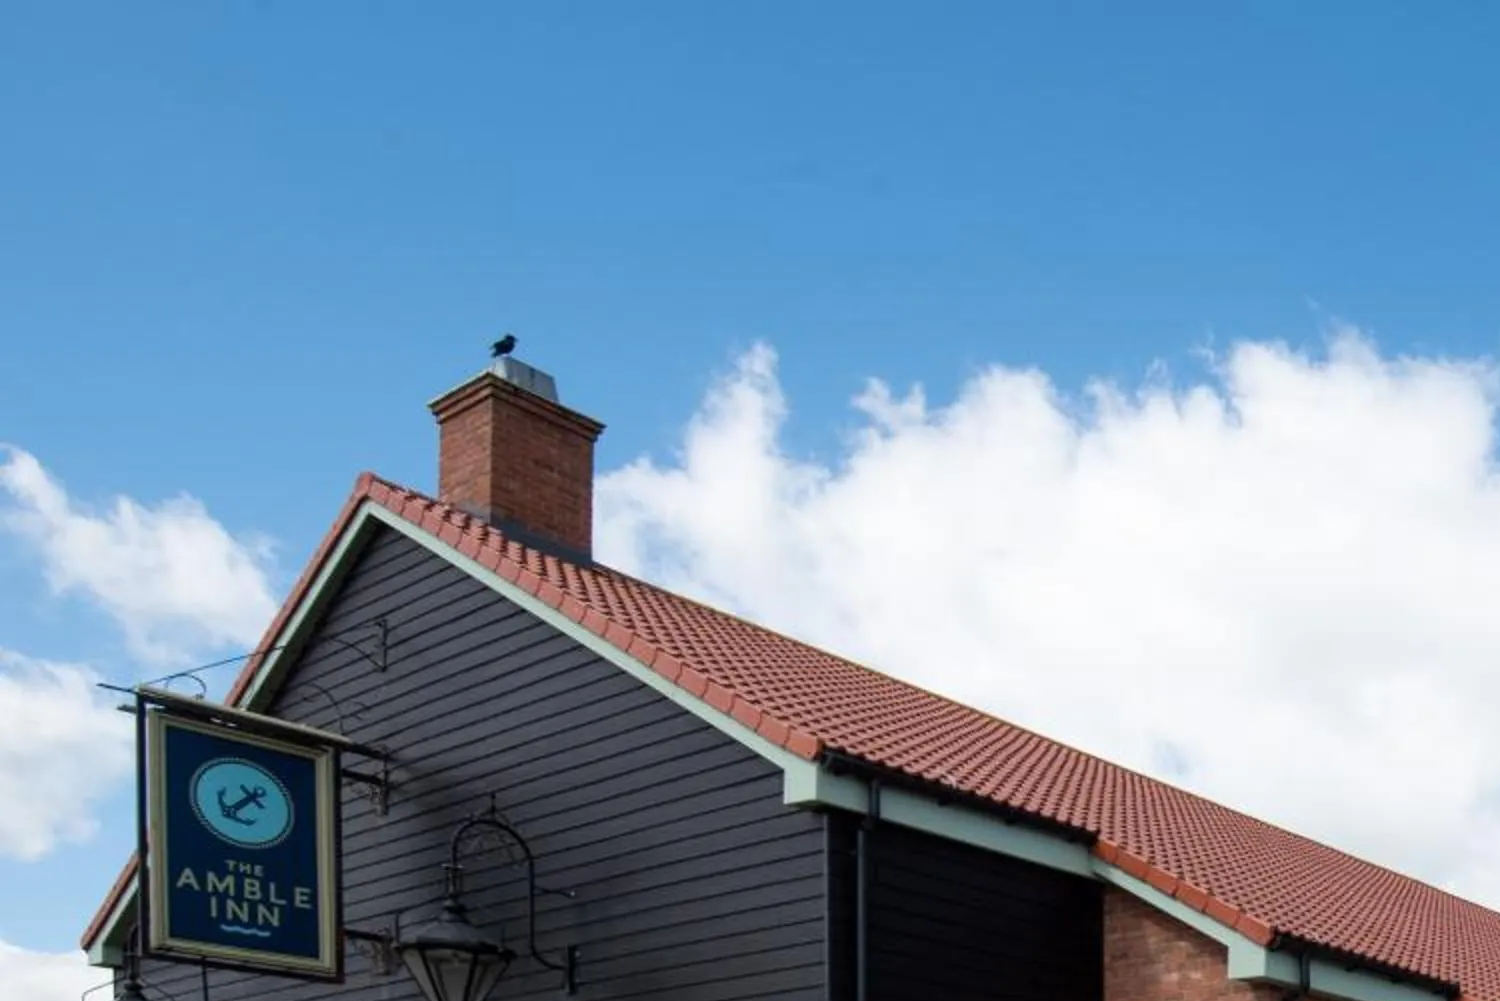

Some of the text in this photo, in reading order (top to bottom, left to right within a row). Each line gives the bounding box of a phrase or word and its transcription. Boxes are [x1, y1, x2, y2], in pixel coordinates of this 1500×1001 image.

[224, 859, 265, 877] THE
[176, 866, 313, 909] AMBLE
[209, 896, 281, 927] INN
